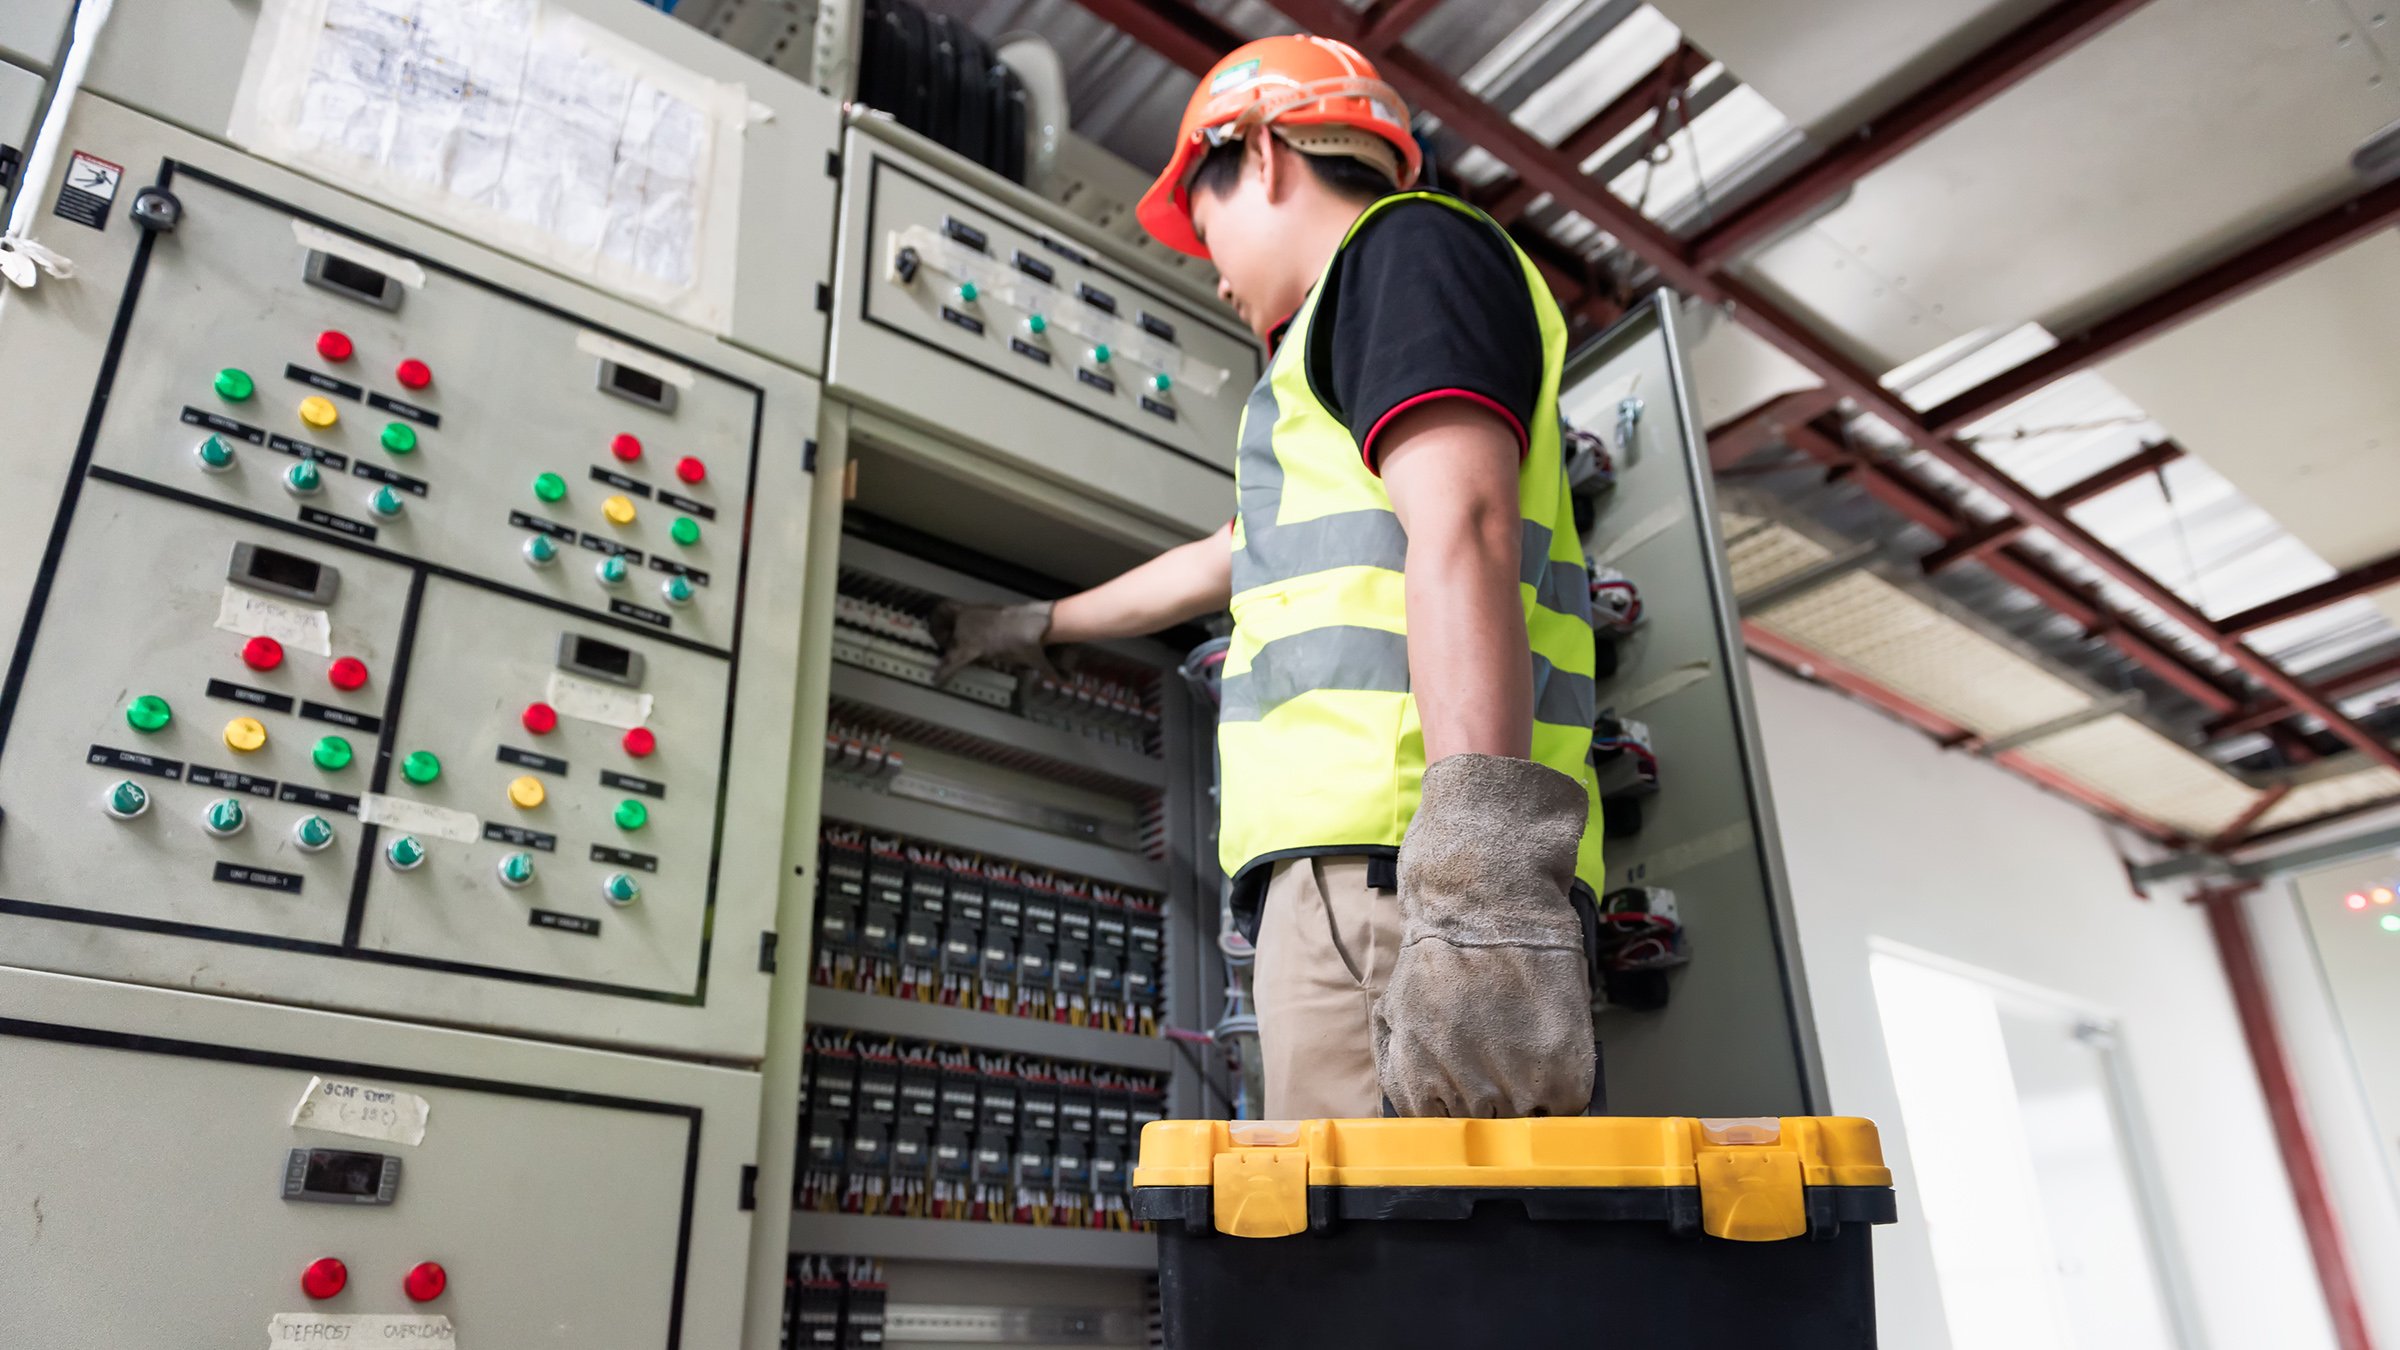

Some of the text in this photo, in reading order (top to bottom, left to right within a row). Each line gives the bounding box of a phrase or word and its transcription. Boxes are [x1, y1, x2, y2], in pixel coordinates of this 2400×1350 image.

[120, 752, 153, 766] CONTROL
[92, 754, 177, 778] OFF ON
[250, 785, 271, 795] AUTO
[282, 791, 297, 801] OFF
[314, 791, 331, 801] FAN
[230, 869, 249, 879] UNIT
[283, 1324, 351, 1342] DEFROST
